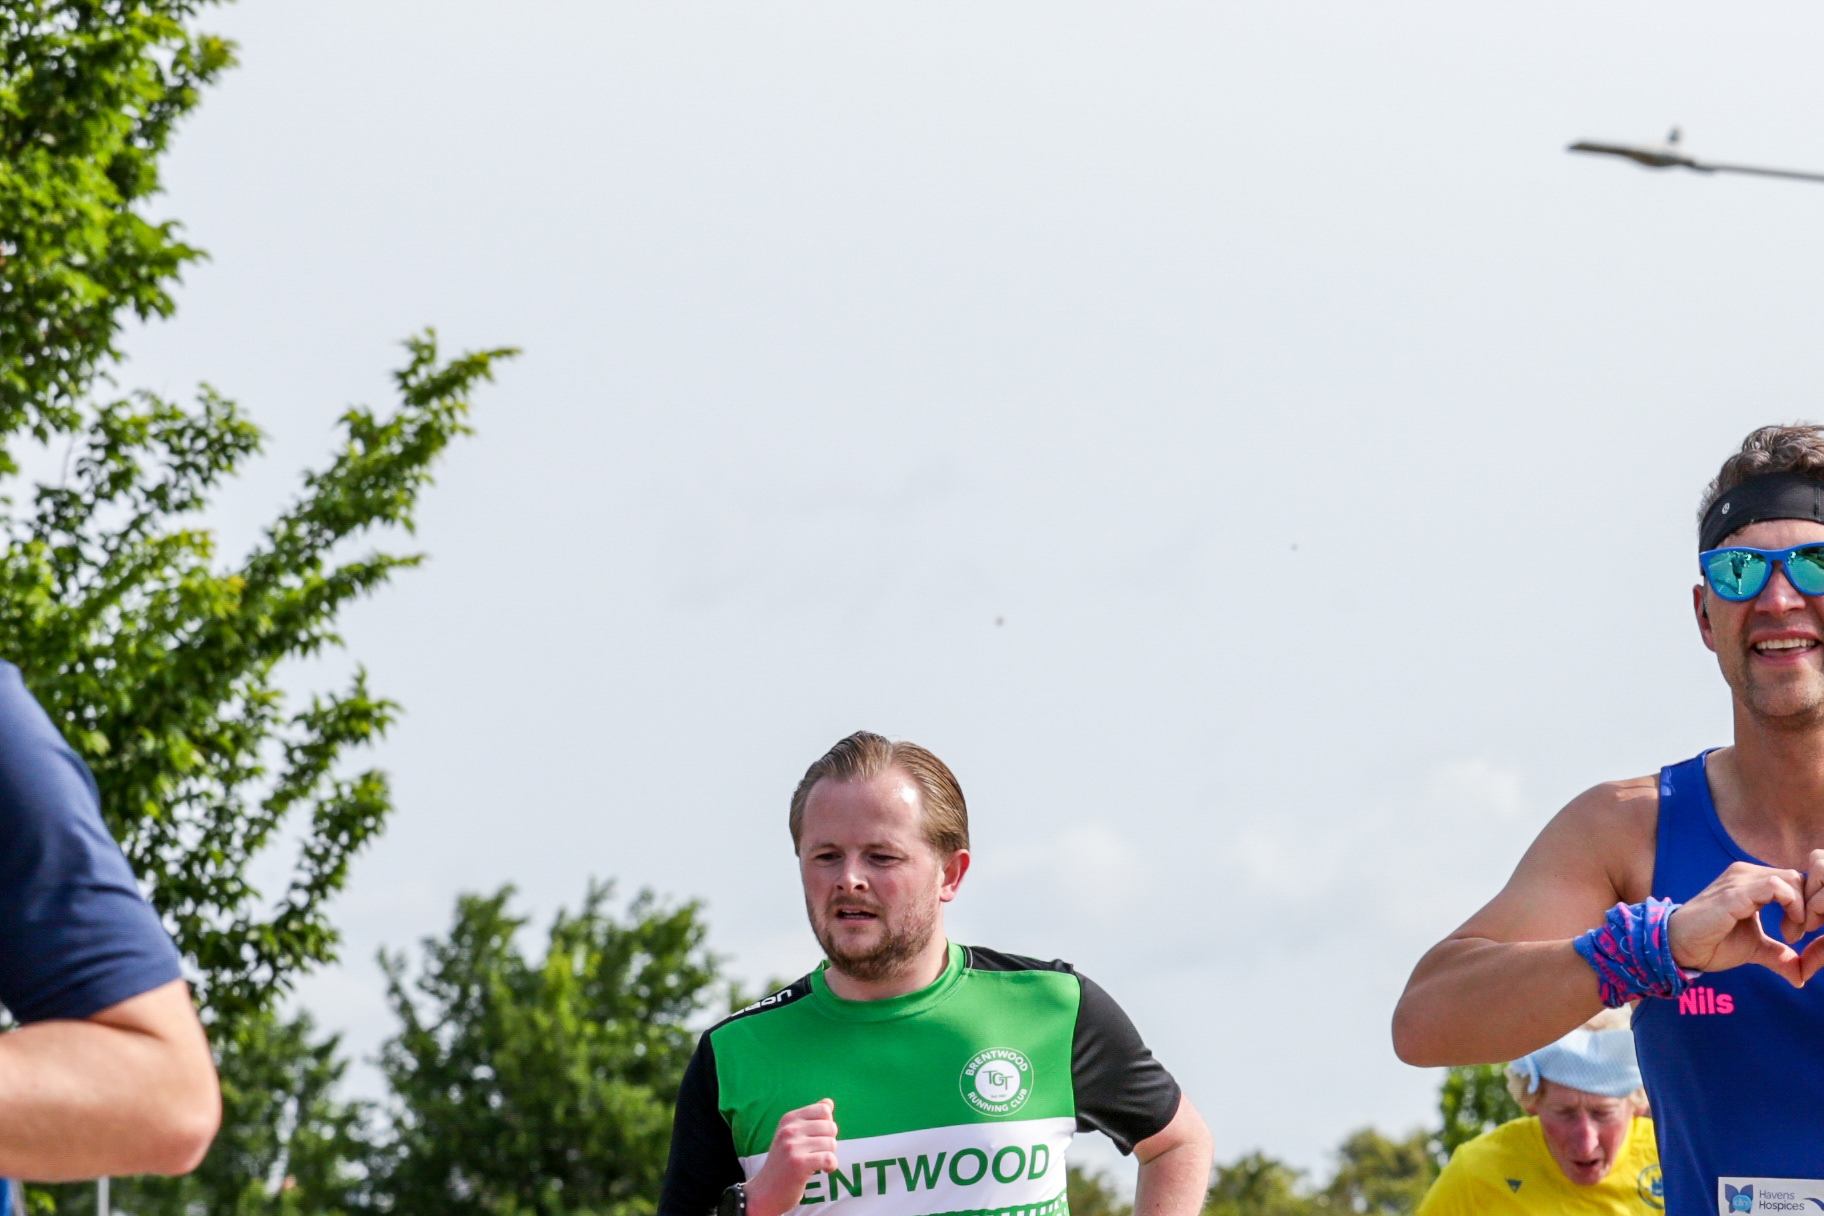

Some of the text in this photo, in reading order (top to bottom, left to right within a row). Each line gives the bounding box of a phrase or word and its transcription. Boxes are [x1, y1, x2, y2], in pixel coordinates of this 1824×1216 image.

[1679, 986, 1734, 1015] Nils
[965, 1050, 1028, 1076] BRENTWOOD
[968, 1088, 1027, 1112] RUNNING CLUB
[800, 1144, 1050, 1205] ENTWOOD
[1759, 1190, 1795, 1200] Havens
[1759, 1200, 1805, 1211] Hospices
